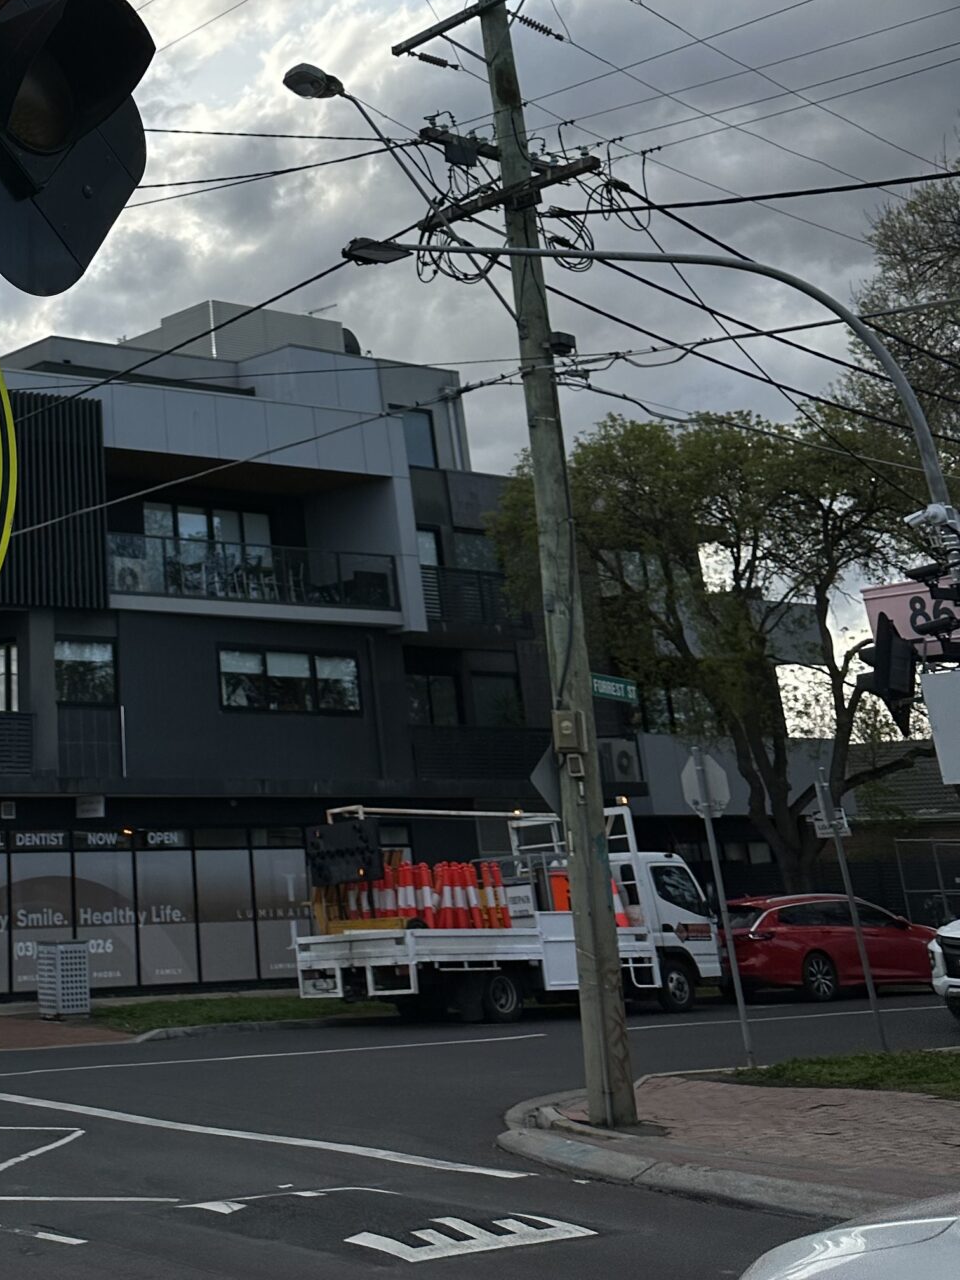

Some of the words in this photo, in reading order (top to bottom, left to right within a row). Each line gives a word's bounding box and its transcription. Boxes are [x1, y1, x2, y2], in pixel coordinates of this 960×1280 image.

[593, 678, 625, 697] FORREST
[16, 832, 64, 846] DENTIST
[87, 832, 118, 845] NOW
[147, 831, 178, 845] OPEN
[16, 907, 69, 926] Smile.
[79, 906, 147, 928] Healthy
[151, 905, 187, 923] Life.
[13, 941, 37, 960] (03)
[88, 939, 113, 954] 026
